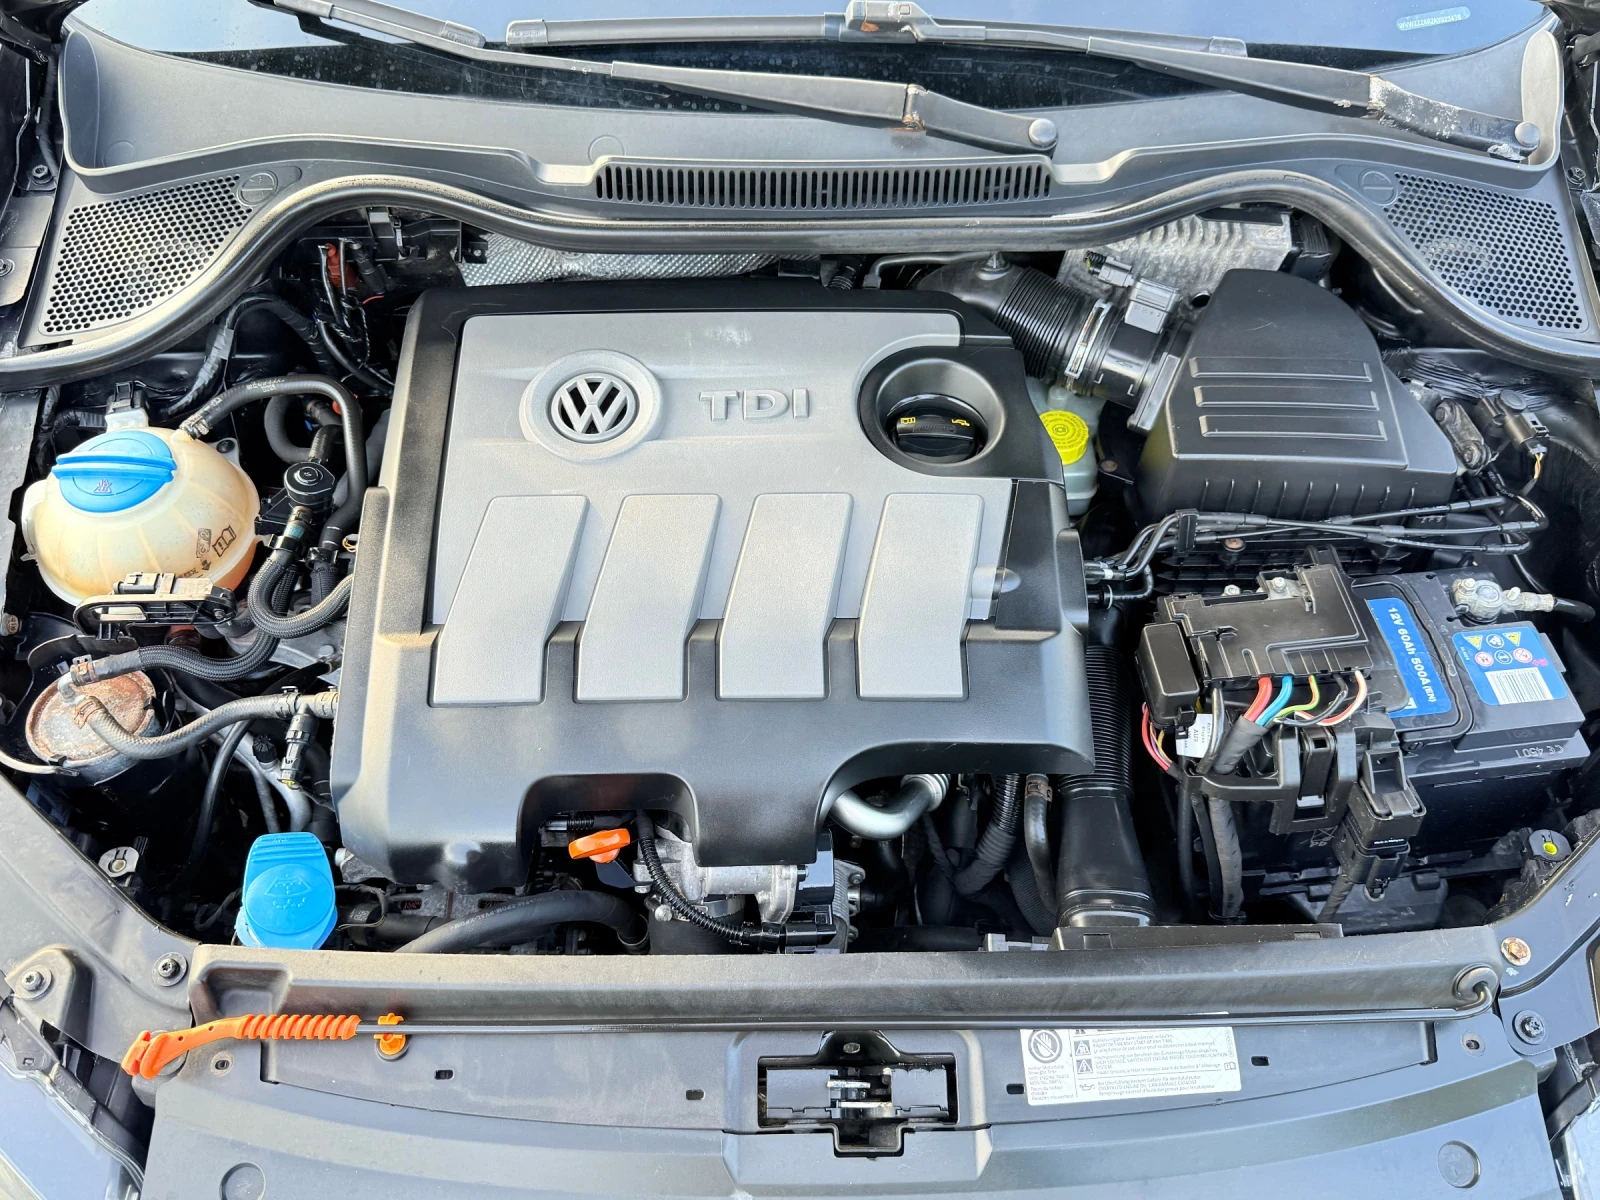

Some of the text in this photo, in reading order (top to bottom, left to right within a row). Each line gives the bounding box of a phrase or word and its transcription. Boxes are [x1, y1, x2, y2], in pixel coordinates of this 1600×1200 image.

[700, 388, 810, 422] TDI
[1388, 607, 1405, 626] 12V
[1397, 628, 1416, 655] 60Ah
